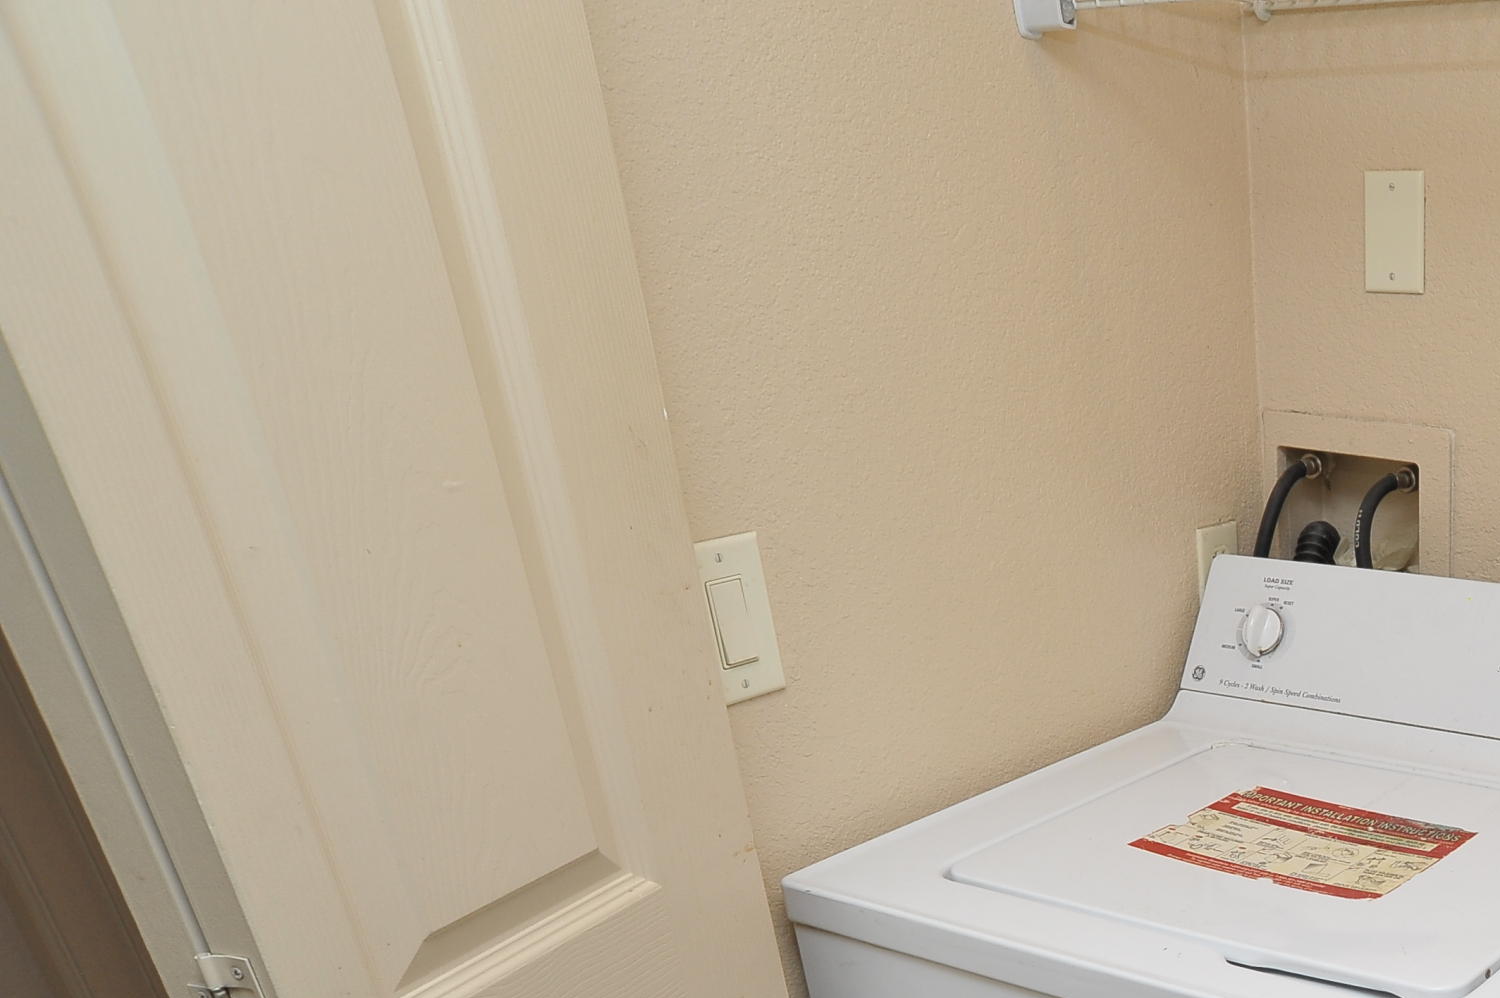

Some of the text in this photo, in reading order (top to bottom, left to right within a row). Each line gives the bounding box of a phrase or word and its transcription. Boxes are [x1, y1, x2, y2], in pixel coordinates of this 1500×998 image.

[1250, 684, 1265, 692] Wash
[1270, 686, 1284, 696] Spin
[1284, 689, 1301, 698] Speed
[1300, 804, 1377, 826] INSTALLATION
